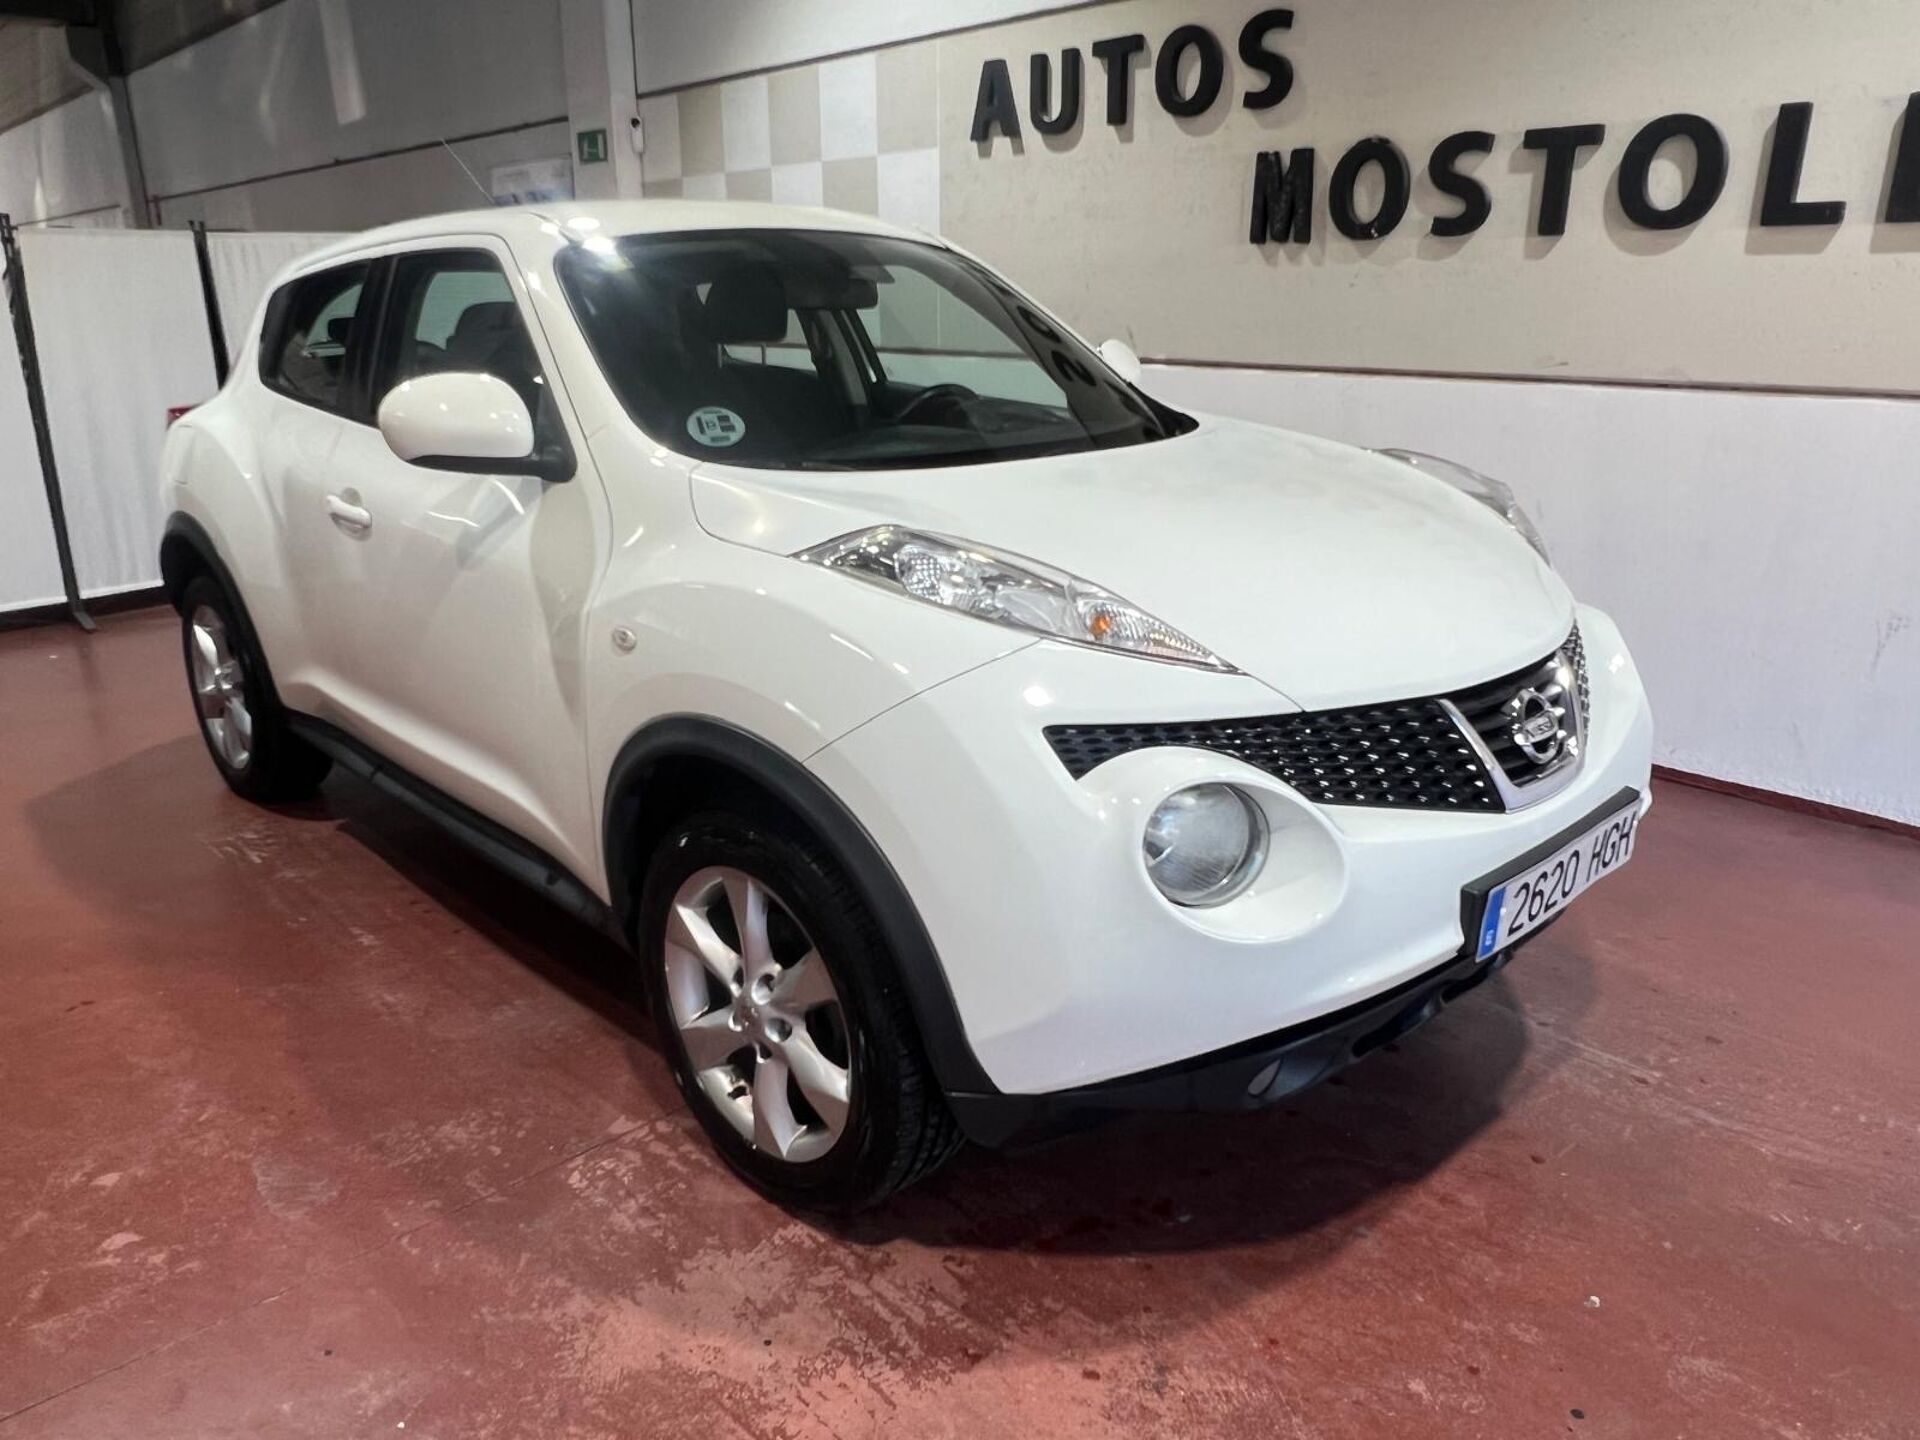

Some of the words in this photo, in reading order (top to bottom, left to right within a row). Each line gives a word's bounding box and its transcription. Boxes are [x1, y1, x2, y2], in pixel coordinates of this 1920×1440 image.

[970, 9, 1294, 142] AUTOS
[1508, 850, 1580, 936] 2620
[1587, 811, 1637, 882] HGH
